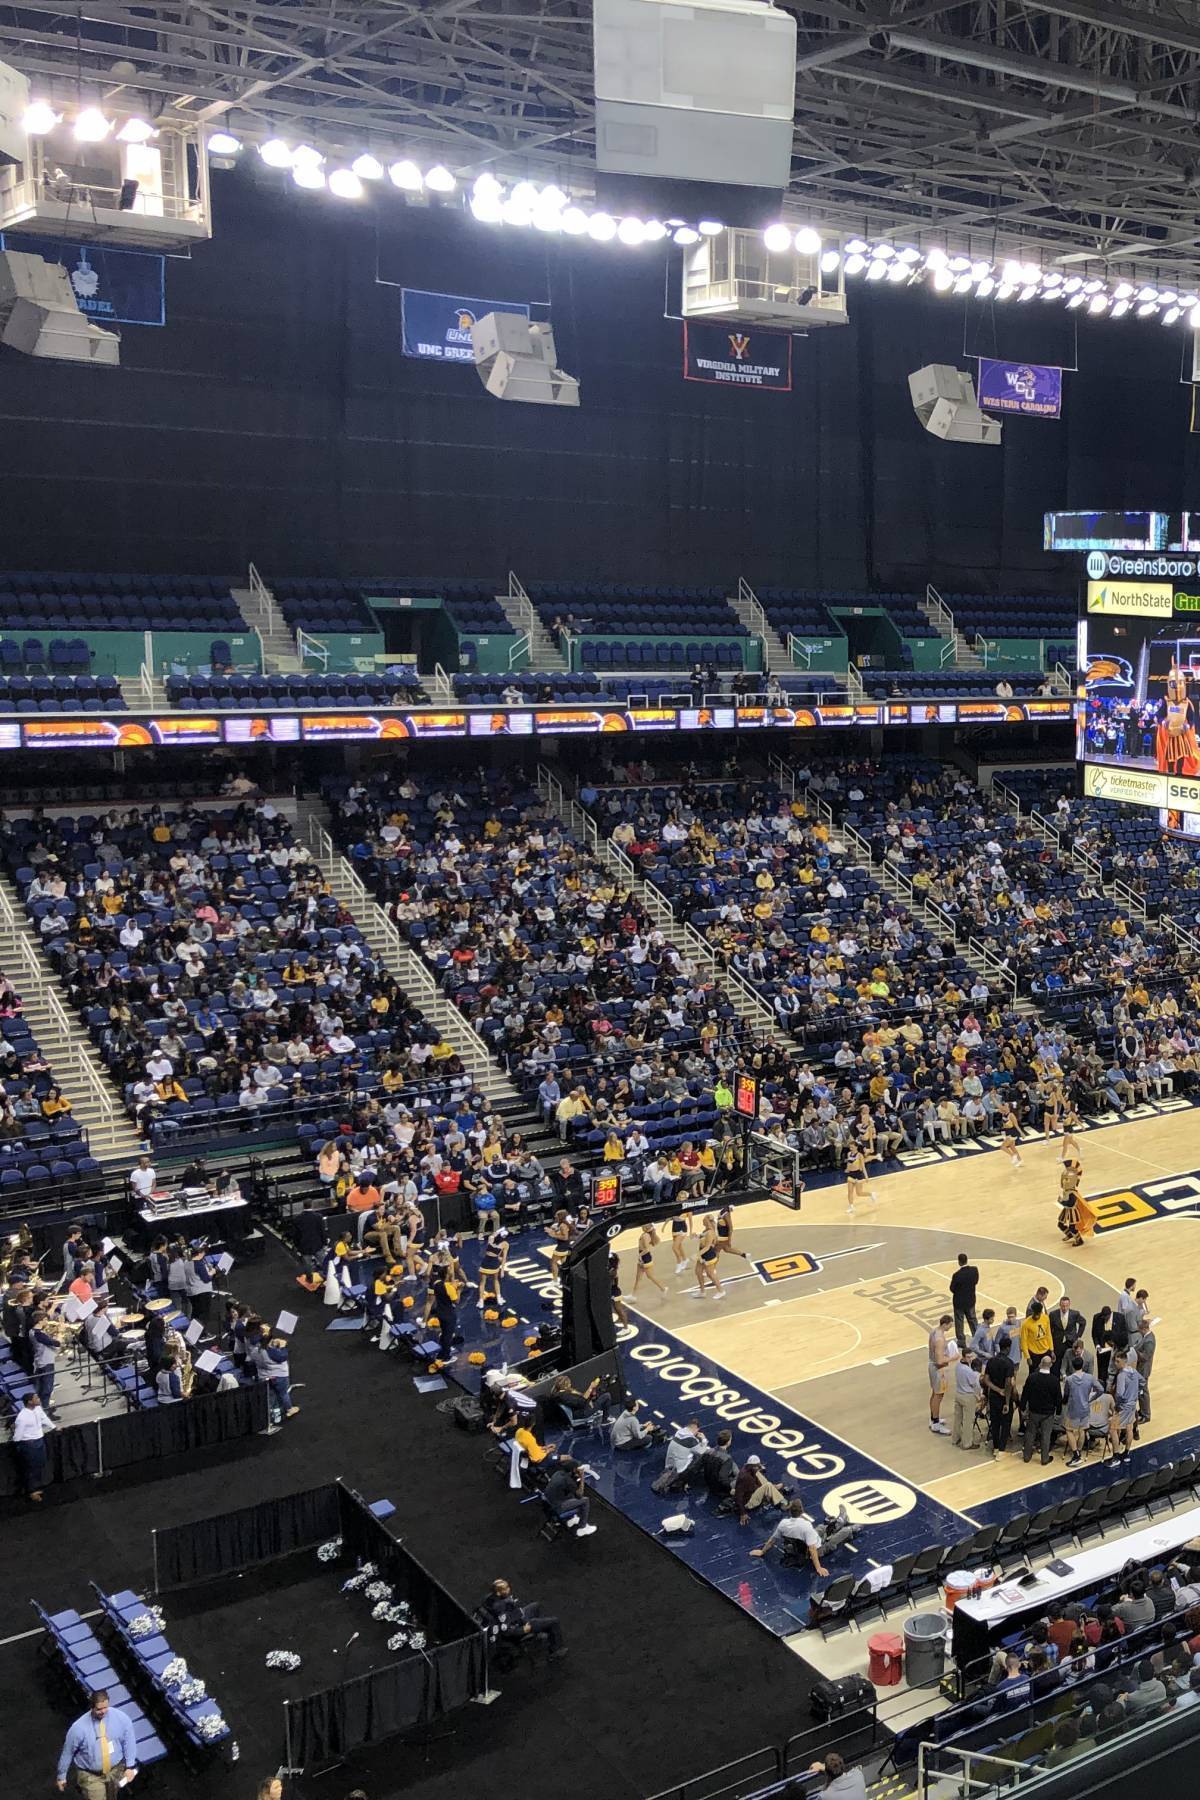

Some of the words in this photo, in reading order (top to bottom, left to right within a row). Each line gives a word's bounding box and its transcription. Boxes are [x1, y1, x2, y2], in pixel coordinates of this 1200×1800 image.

[417, 343, 443, 356] UNC
[696, 358, 737, 372] VIRGINIA
[738, 364, 780, 377] MILITARY
[715, 371, 763, 384] INSTITUTE
[983, 396, 1020, 409] WESTERN
[1021, 401, 1057, 413] CAROLINA
[1108, 556, 1193, 577] Greensboro
[1112, 591, 1171, 609] NorthState
[1110, 776, 1157, 791] ticketmaster
[741, 1077, 755, 1092] 3:59
[599, 1179, 617, 1191] 3:59
[597, 1189, 616, 1204] 30
[629, 1343, 846, 1480] Greensboro
